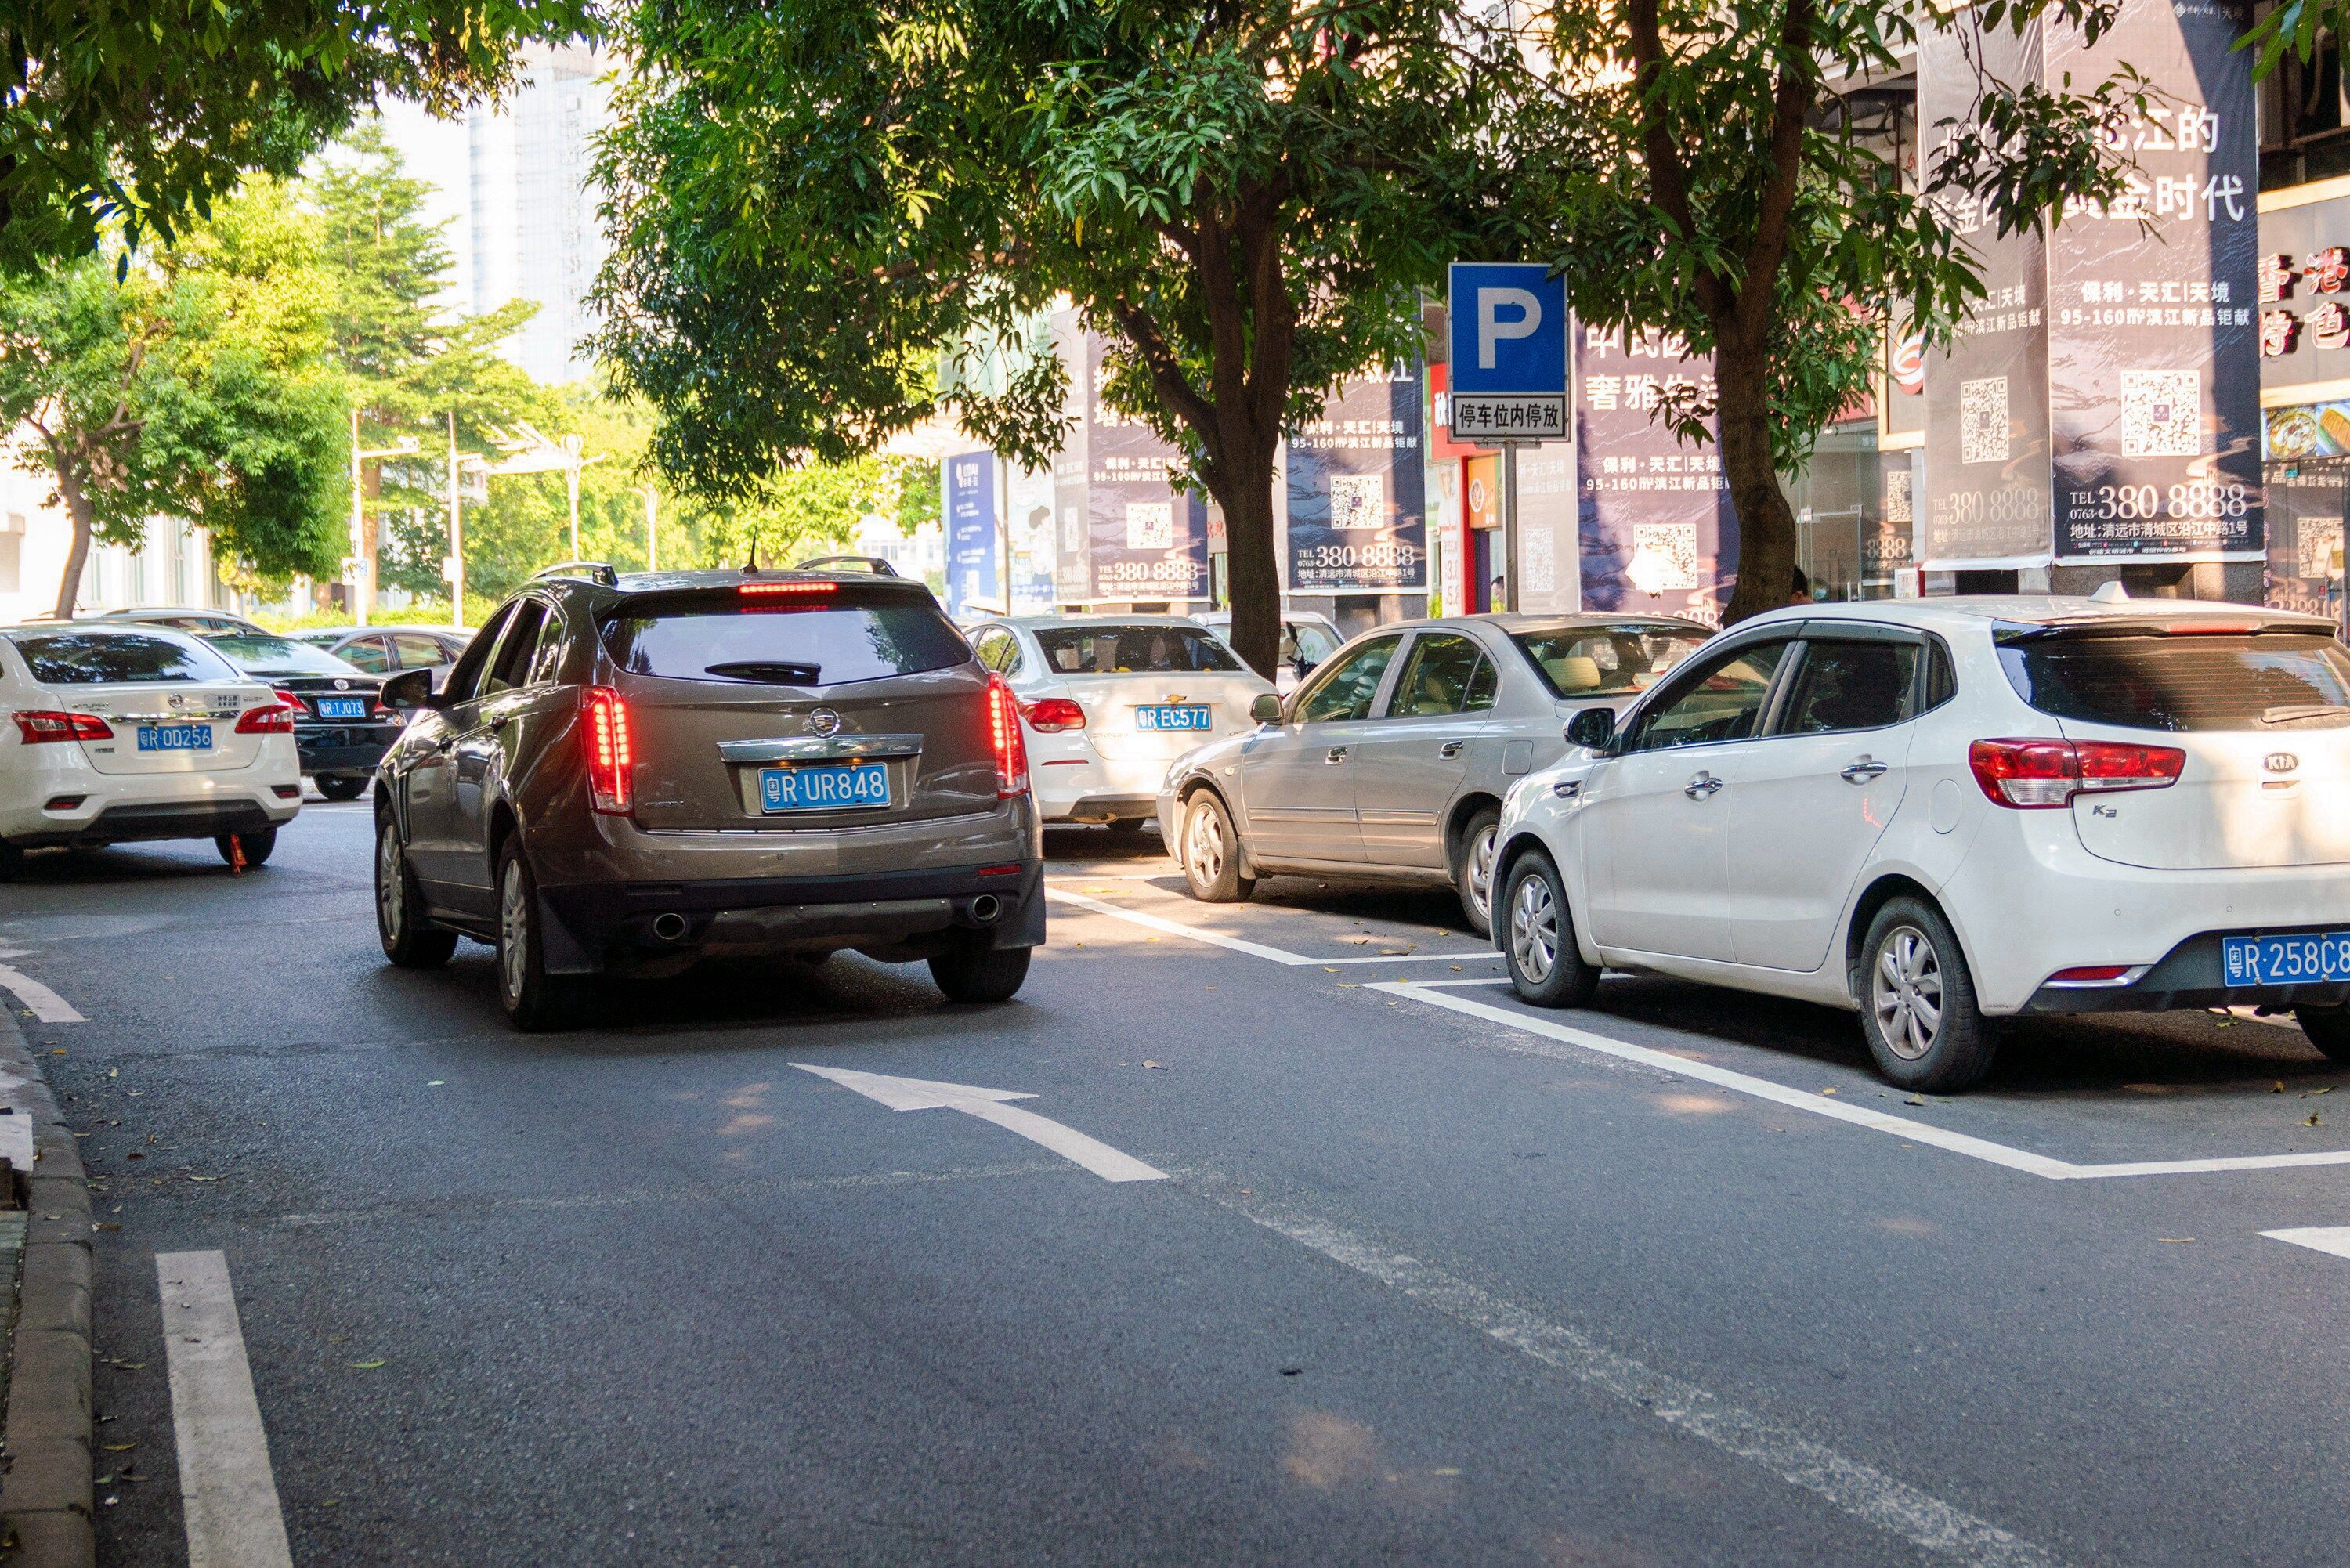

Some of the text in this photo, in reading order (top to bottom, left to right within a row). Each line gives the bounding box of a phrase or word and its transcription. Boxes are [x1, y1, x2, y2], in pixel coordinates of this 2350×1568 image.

[1478, 287, 1542, 369] P
[1459, 403, 1559, 428] 停车位内停放
[1949, 487, 2039, 525] 380 8888
[2070, 492, 2095, 505] TEL
[2098, 483, 2247, 519] 380 8888
[2070, 508, 2098, 520] 0763-
[1297, 549, 1315, 558] TEL
[1315, 545, 1415, 568] 380 8888
[1114, 562, 1198, 581] 380 8888
[2268, 753, 2296, 770] KIA
[766, 771, 884, 803] 粤R·UR848
[2092, 804, 2117, 818] K2
[2229, 939, 2350, 978] 粤R·258C8
